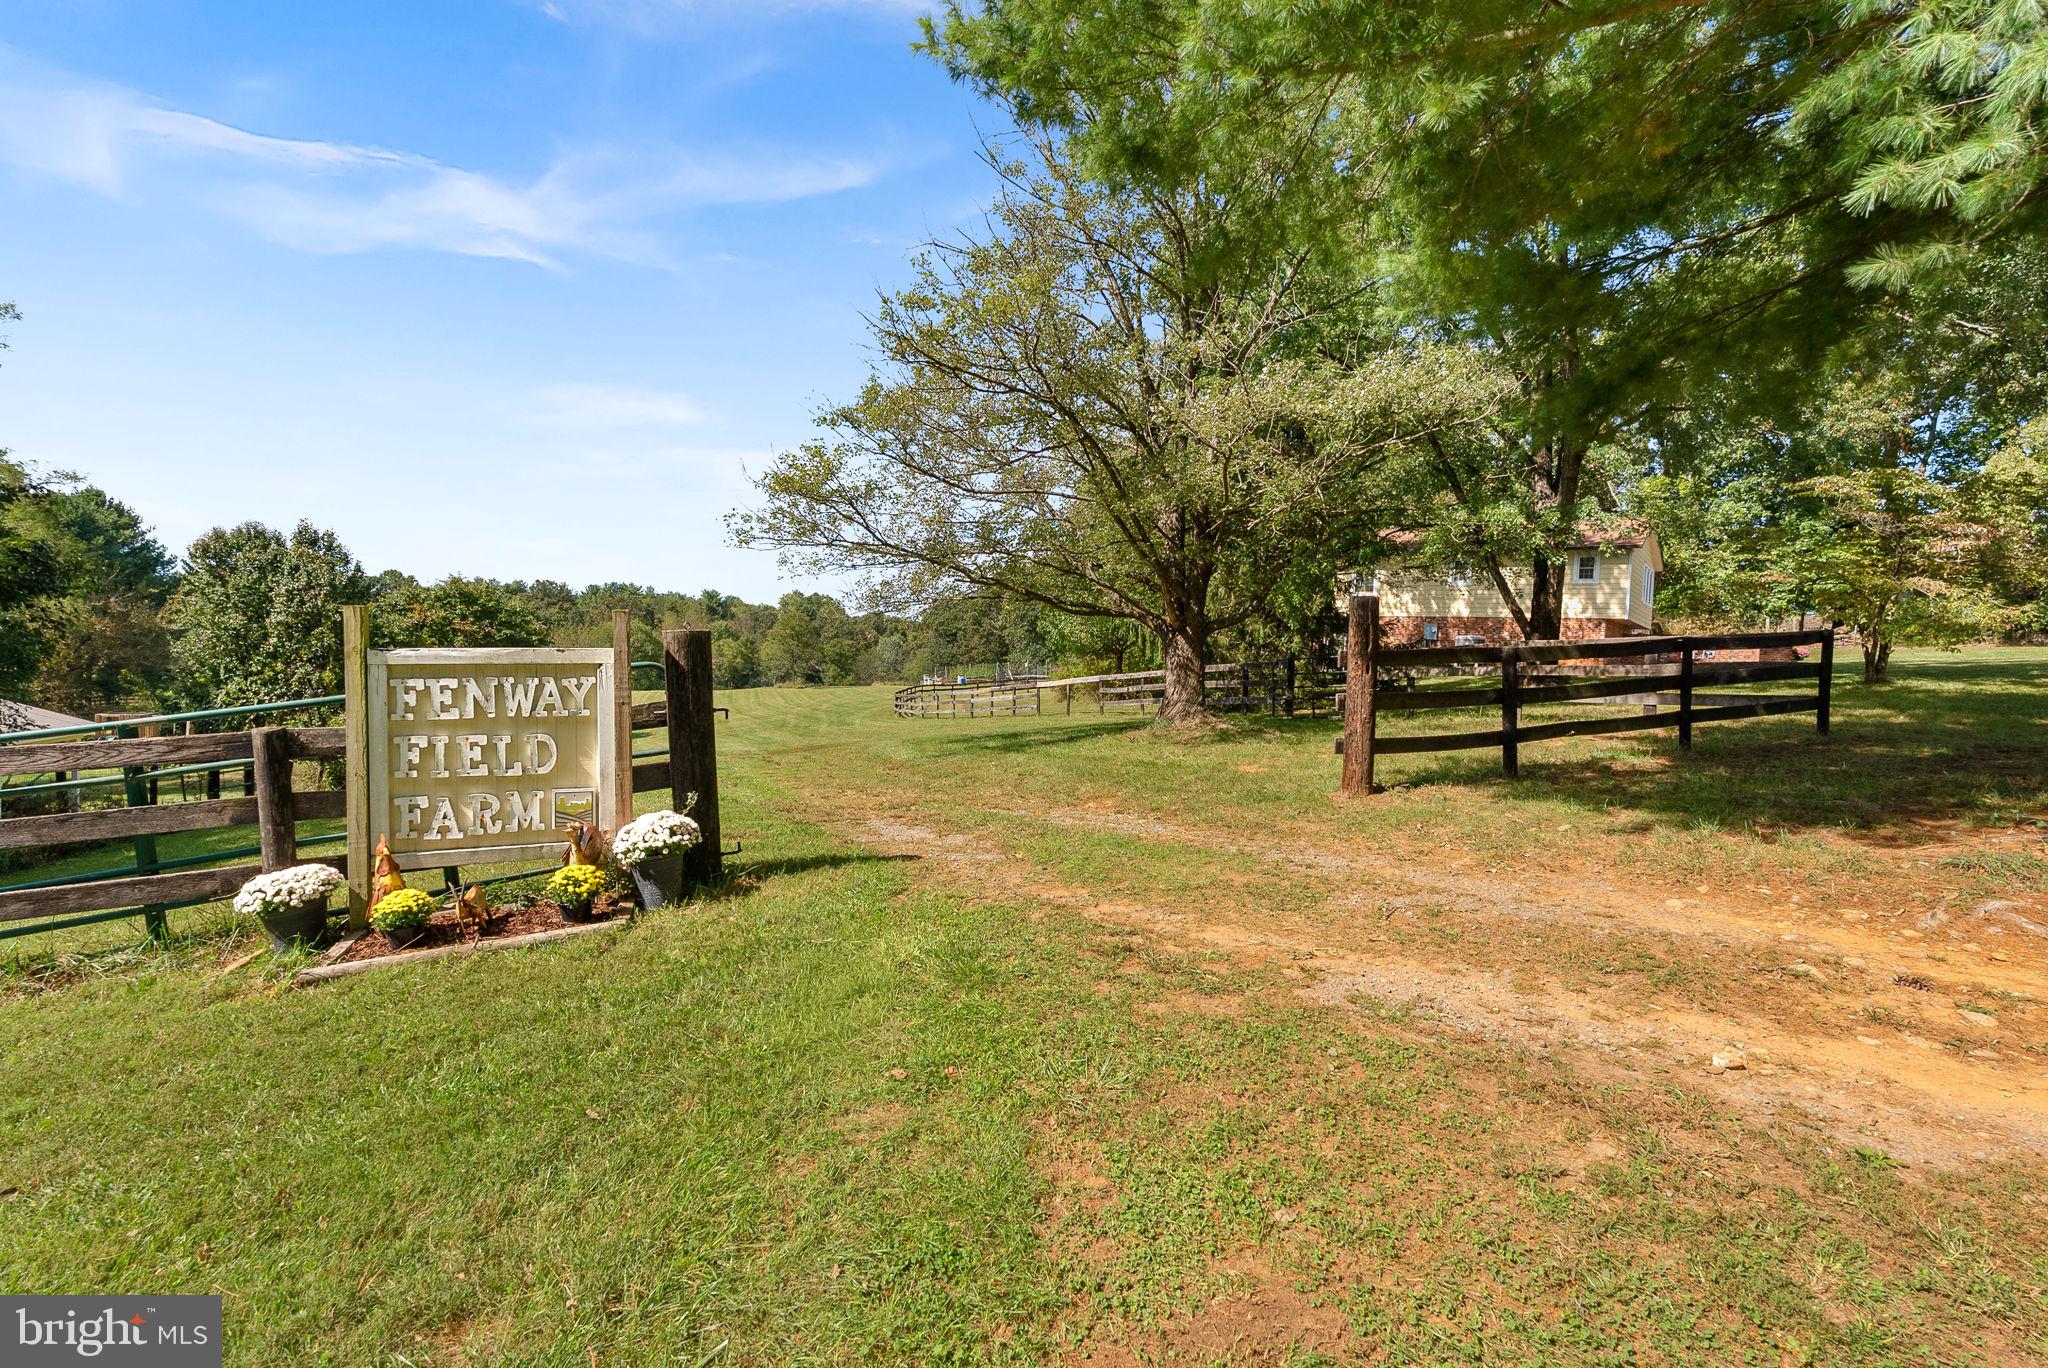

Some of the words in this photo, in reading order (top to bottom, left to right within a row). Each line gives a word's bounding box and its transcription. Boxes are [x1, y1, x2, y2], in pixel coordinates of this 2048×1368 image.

[389, 676, 596, 721] FENWAY
[393, 733, 557, 778] FIELD
[393, 790, 545, 840] FARM
